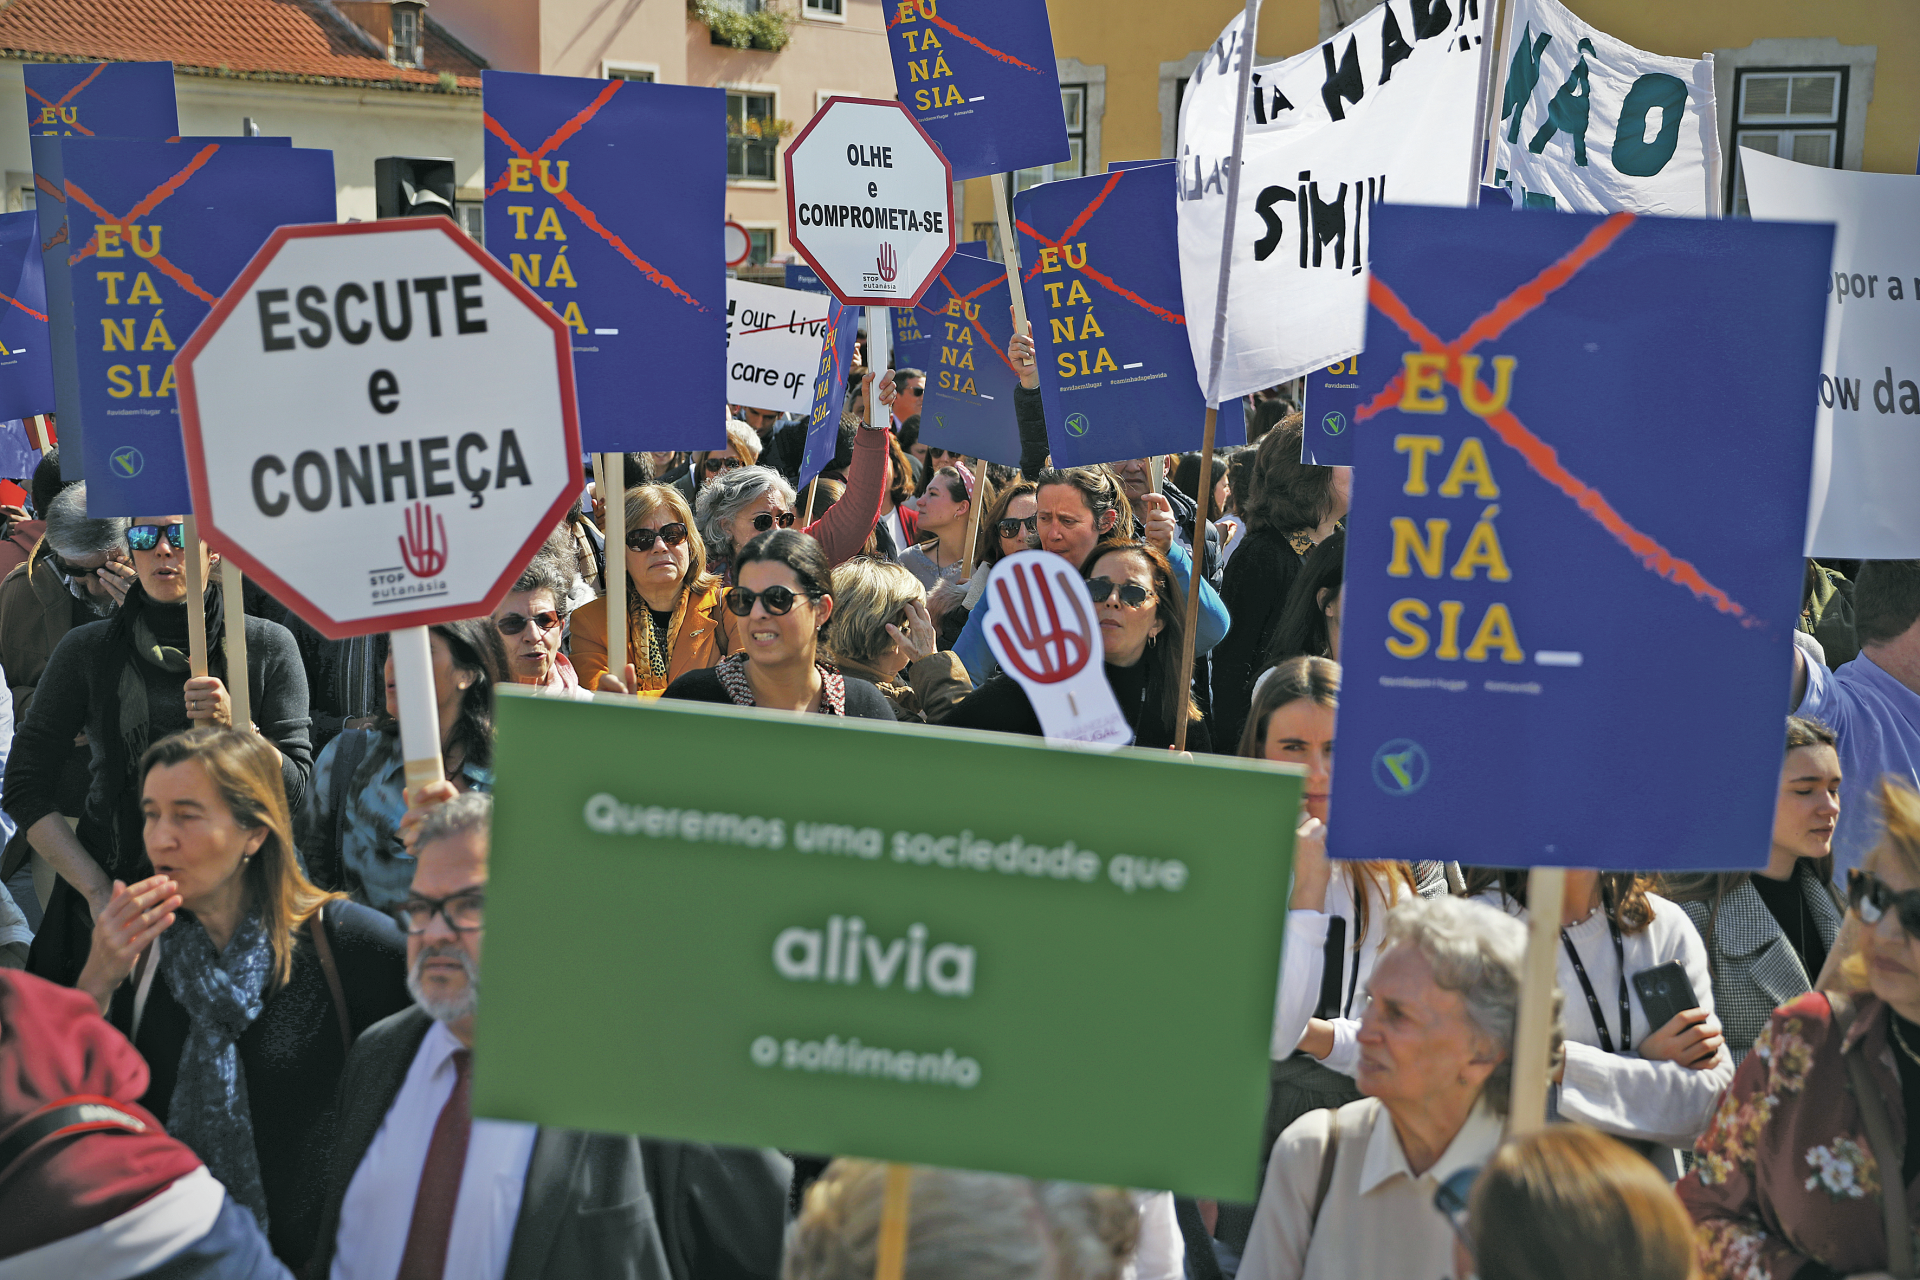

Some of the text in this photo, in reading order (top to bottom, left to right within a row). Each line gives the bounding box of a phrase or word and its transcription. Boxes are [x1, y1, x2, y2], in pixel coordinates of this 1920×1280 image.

[898, 0, 937, 24] EU
[902, 28, 942, 53] TA
[907, 50, 953, 82] NÁ
[41, 107, 78, 124] EU
[1501, 20, 1688, 178] NÃO
[847, 143, 893, 169] OLHE
[507, 158, 570, 194] EU
[867, 181, 878, 198] e
[507, 206, 568, 241] TA
[798, 203, 944, 234] COMPROMETA-SE
[94, 224, 163, 259] EU
[1039, 242, 1087, 274] EU
[509, 245, 578, 288] NÁ
[97, 271, 163, 305] TA
[1044, 279, 1092, 308] TA
[1887, 276, 1904, 301] a
[256, 273, 488, 352] ESCUTE
[741, 309, 776, 329] our
[947, 298, 981, 321] EU
[1050, 306, 1105, 344] NÁ
[100, 308, 176, 351] NÁ
[825, 328, 838, 351] EU
[945, 322, 973, 346] TA
[821, 355, 831, 376] TA
[940, 346, 975, 371] NÁ
[1327, 355, 1359, 375] SI
[106, 364, 178, 398] SIA
[368, 368, 400, 415] e
[731, 362, 779, 386] care
[783, 372, 806, 400] of
[1398, 351, 1518, 418] EU
[1817, 373, 1861, 412] ow
[251, 428, 533, 518] CONHEÇA
[1393, 433, 1500, 500] TA
[1386, 503, 1513, 582] NÁ
[370, 572, 405, 587] STOP
[371, 579, 448, 599] eutanásia
[583, 793, 1190, 895] Queremos uma sociedade que
[772, 914, 978, 998] alivia
[751, 1034, 982, 1090] o sofrimento
